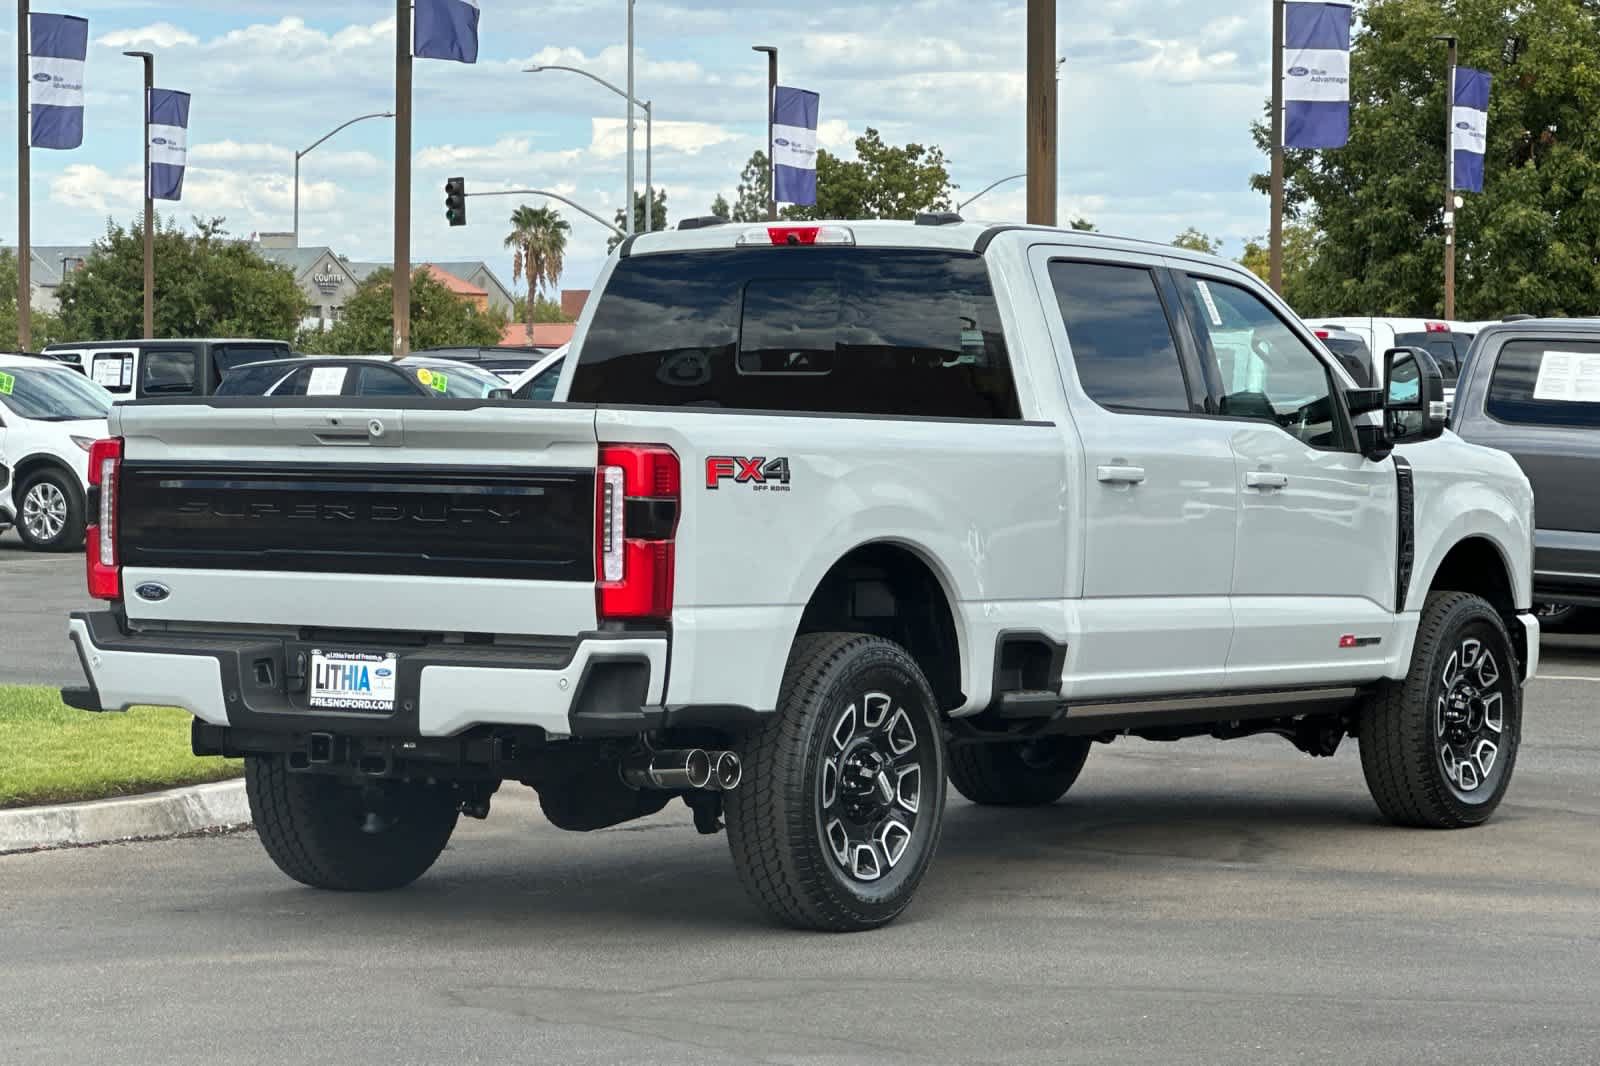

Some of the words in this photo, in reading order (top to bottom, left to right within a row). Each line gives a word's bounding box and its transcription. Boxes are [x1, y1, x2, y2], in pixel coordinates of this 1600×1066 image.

[314, 273, 346, 282] COUNTRY
[705, 456, 790, 489] FX4
[176, 501, 356, 520] SUPER
[370, 503, 521, 525] DUTY
[316, 664, 370, 691] LITHIA
[310, 698, 393, 710] FRESNOFORD.COM
